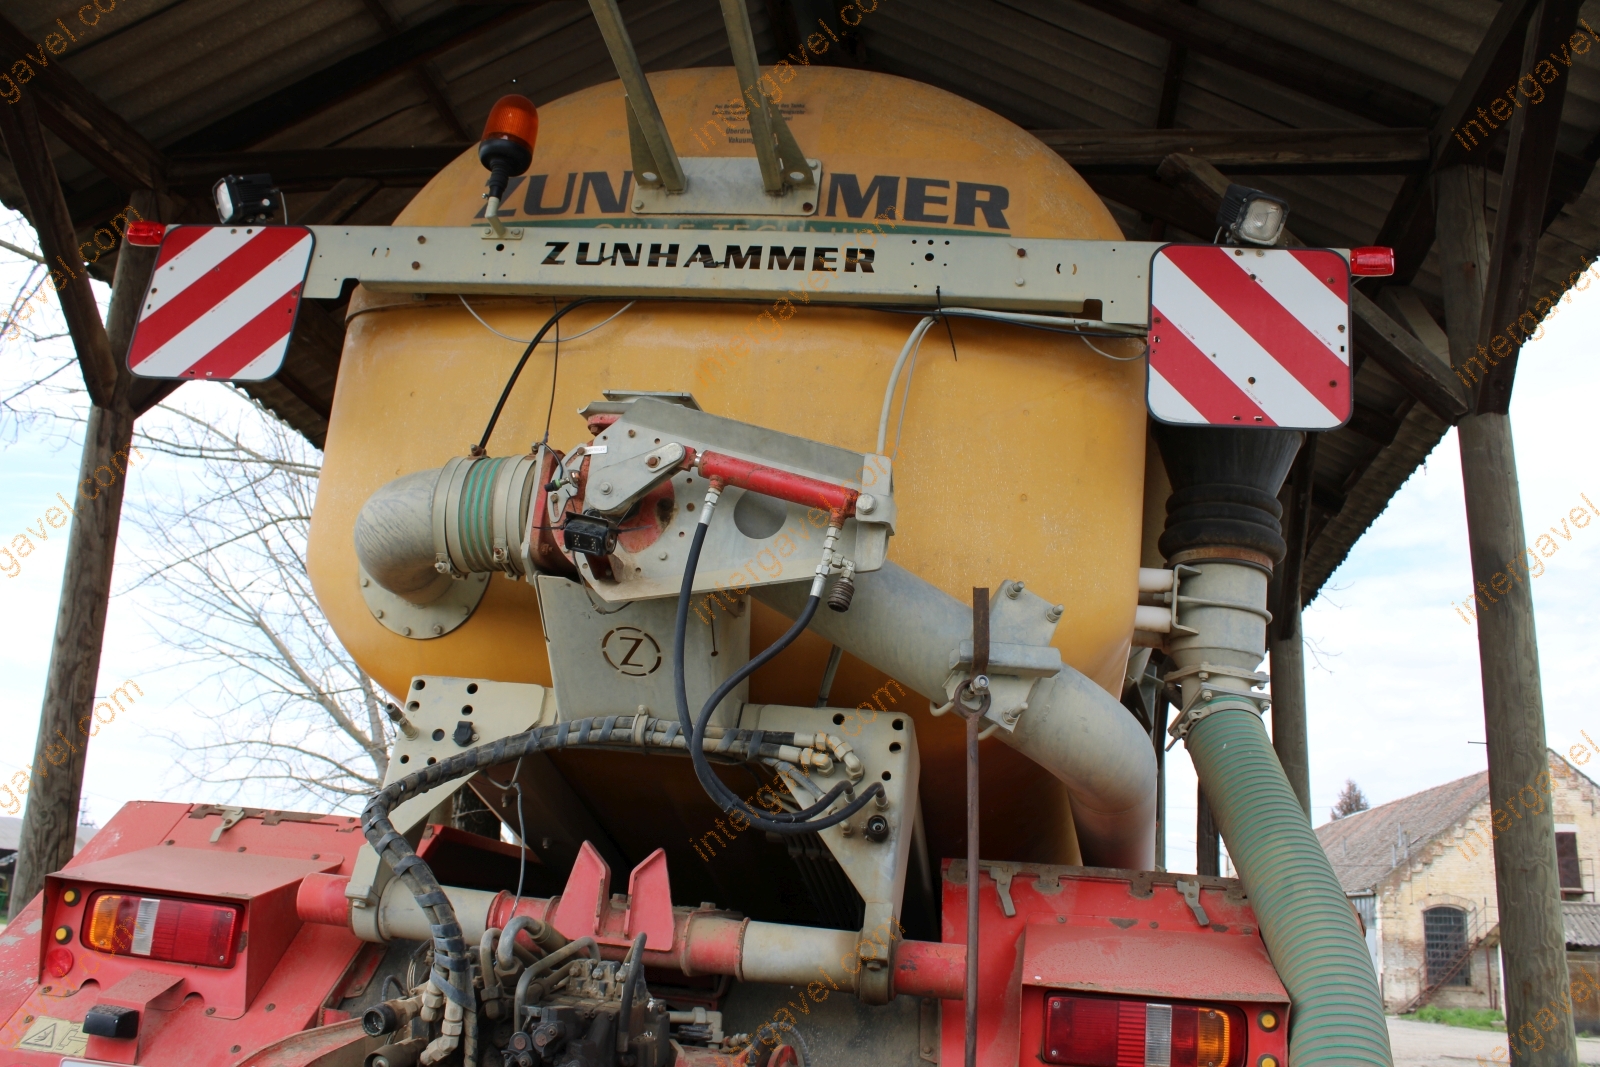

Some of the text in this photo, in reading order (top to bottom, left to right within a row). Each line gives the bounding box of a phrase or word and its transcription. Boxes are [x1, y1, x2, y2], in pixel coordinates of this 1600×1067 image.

[726, 127, 752, 135] Überdru
[728, 136, 754, 144] Vakuum
[473, 170, 1010, 230] ZUNMER
[541, 241, 875, 273] ZUNHAMMER
[619, 636, 644, 668] Z
